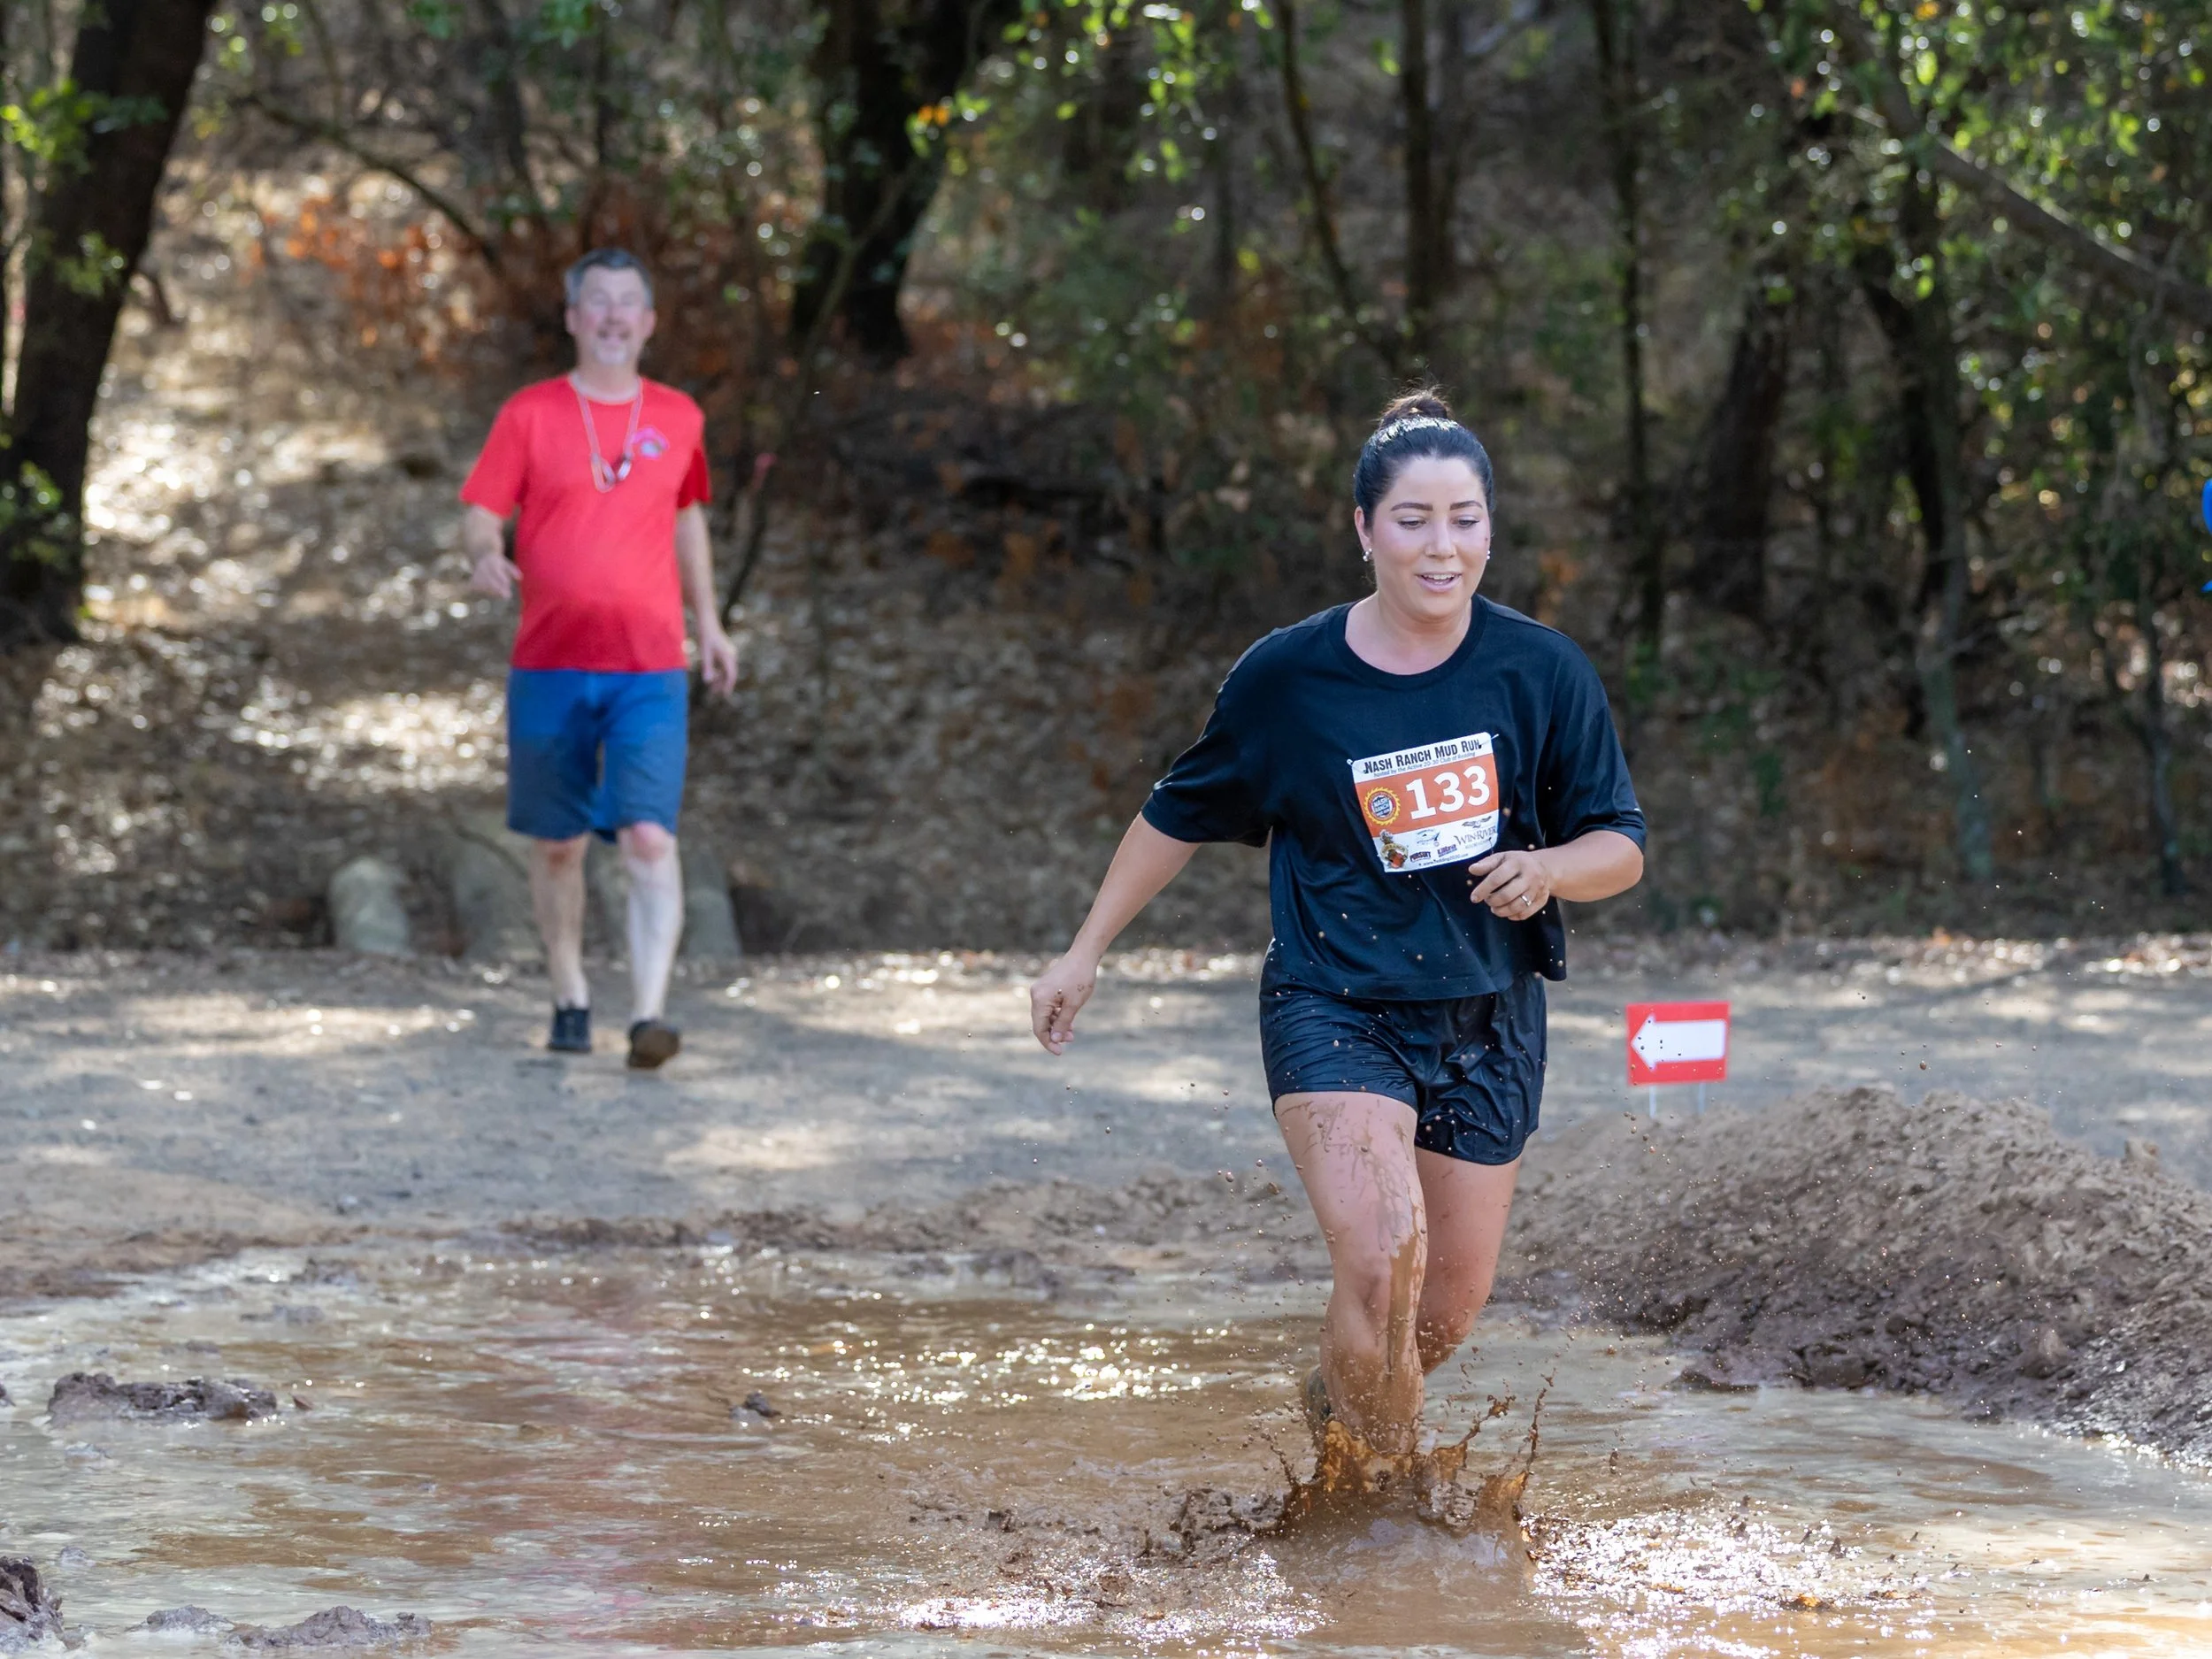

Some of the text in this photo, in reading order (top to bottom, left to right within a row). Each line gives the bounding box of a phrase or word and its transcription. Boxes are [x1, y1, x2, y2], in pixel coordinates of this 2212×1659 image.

[1364, 739, 1480, 774] NASH RANCH MUD RUN
[1405, 764, 1490, 820] 133
